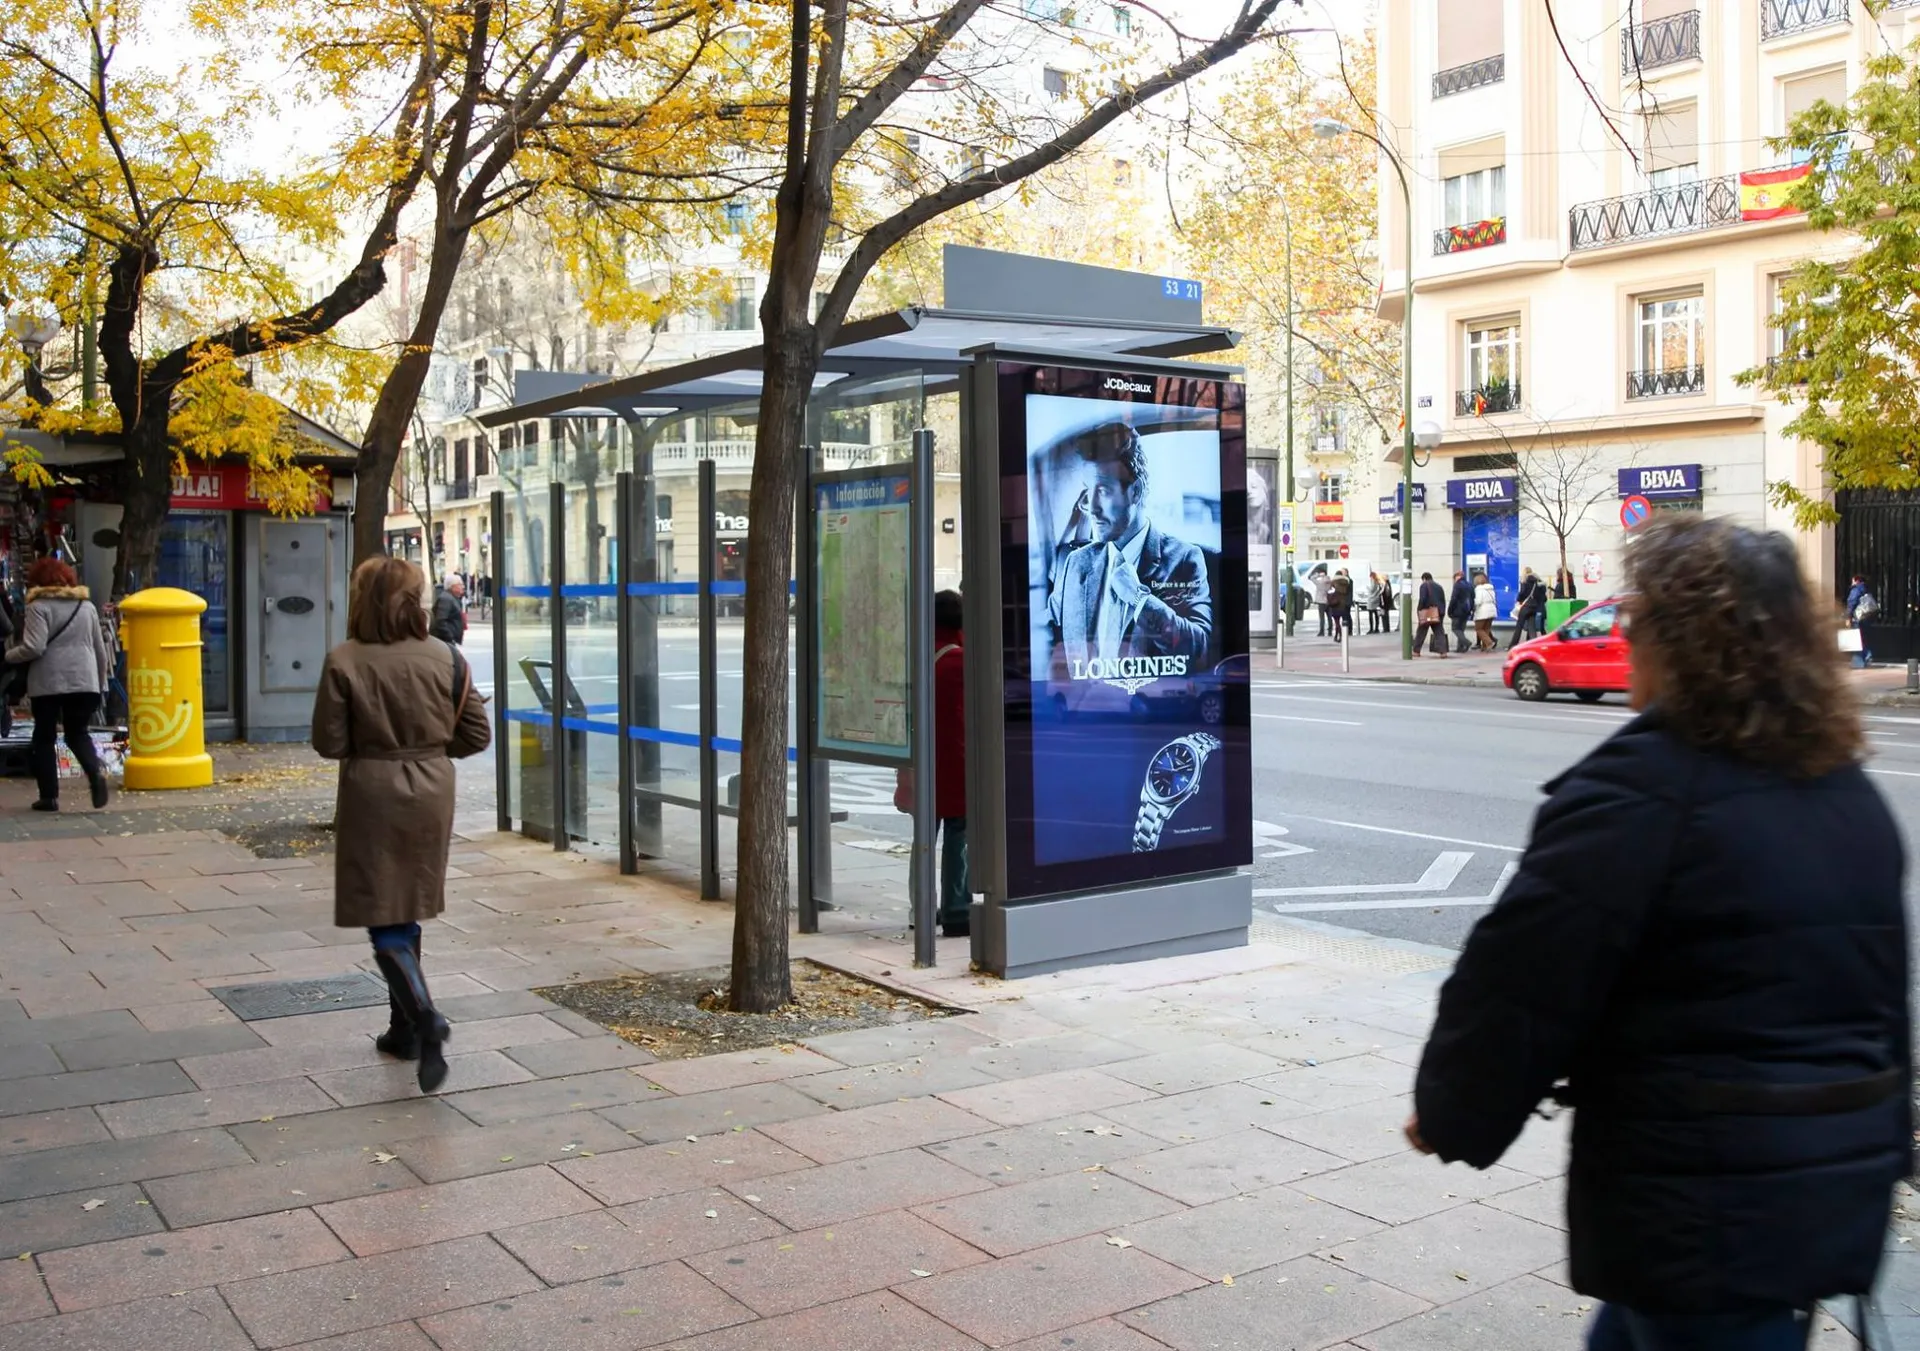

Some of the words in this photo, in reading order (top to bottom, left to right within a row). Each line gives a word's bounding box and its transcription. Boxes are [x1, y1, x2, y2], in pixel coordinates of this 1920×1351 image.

[1165, 279, 1179, 295] 53
[1186, 283, 1198, 299] 21
[1103, 377, 1152, 394] JCDecaux
[171, 475, 219, 498] OLA!
[1640, 468, 1686, 489] BBVA
[836, 482, 886, 503] Información
[1465, 480, 1504, 499] BBVA
[655, 515, 674, 533] nac
[715, 511, 750, 530] fna
[1073, 654, 1188, 680] LONGINES
